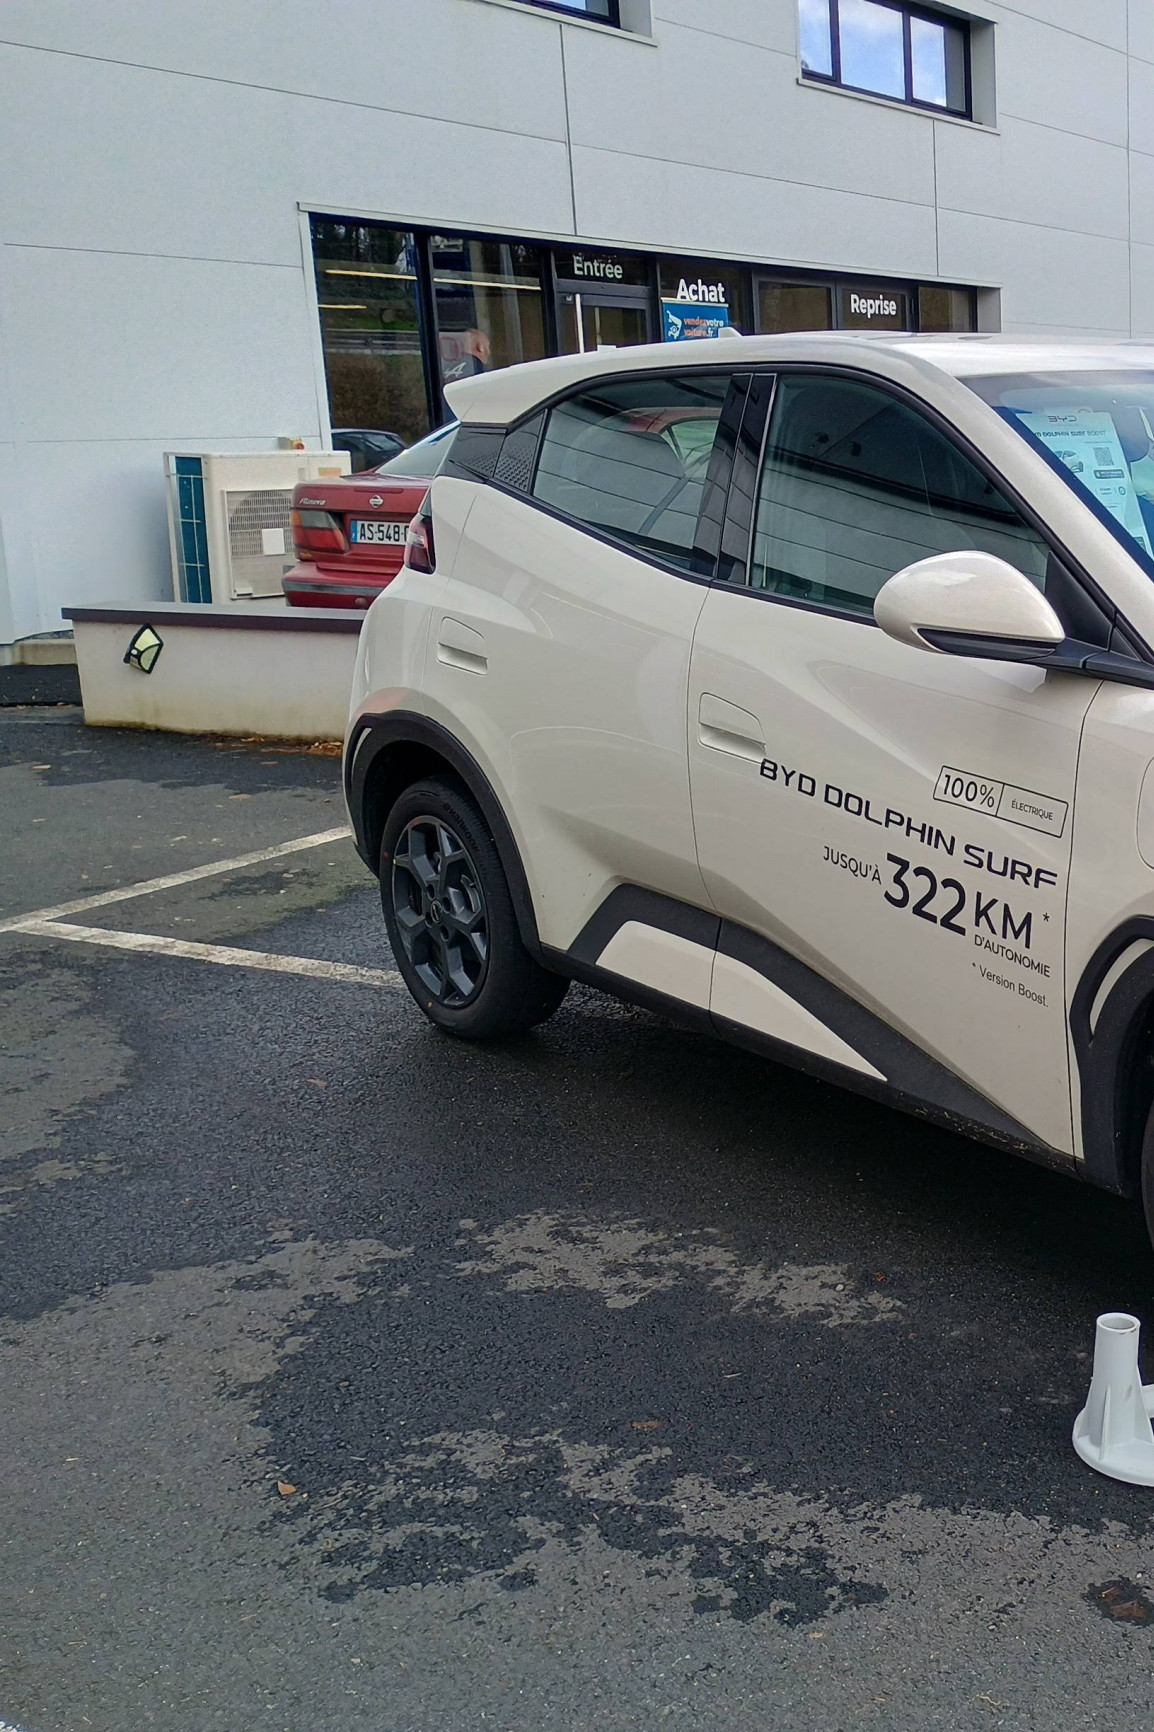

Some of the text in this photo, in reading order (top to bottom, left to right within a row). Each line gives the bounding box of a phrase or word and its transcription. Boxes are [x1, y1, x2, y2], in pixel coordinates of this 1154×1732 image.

[573, 256, 624, 279] Entrée
[676, 279, 725, 303] Achat
[850, 293, 897, 319] Reprise
[943, 773, 1054, 821] 100% ÉLECTRIQUE
[760, 758, 1058, 889] BYD DOLPHIN SURF
[884, 852, 967, 937] 322
[974, 934, 1051, 978] D'AUTONOMIE
[979, 964, 1016, 993] Version
